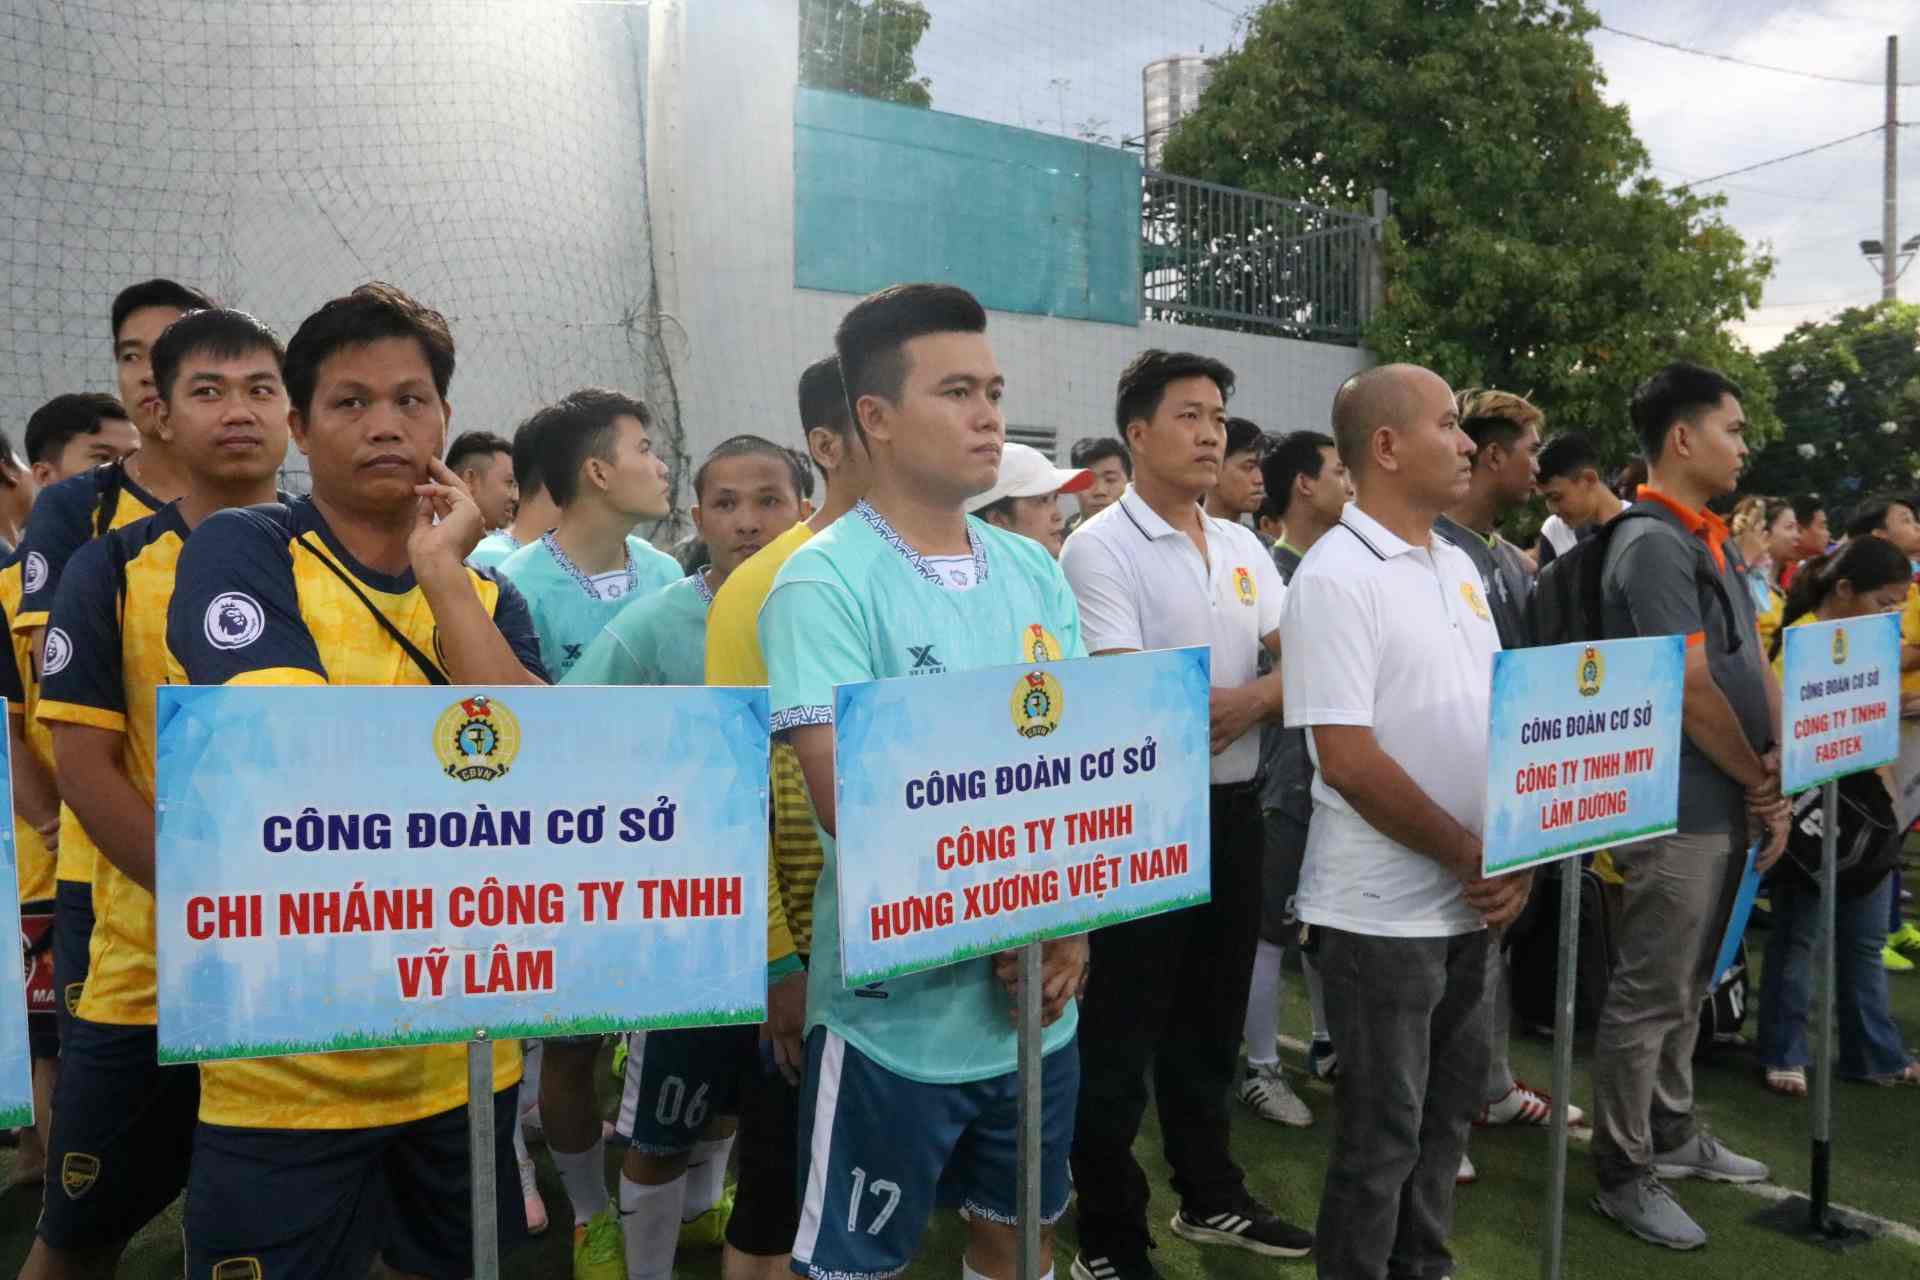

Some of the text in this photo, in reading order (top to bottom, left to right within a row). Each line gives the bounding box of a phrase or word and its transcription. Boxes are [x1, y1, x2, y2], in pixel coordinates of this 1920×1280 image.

[1521, 700, 1652, 745] CÔNG ĐOÀN CƠ SỞ
[1794, 701, 1887, 740] CÔNG TY TNHH
[906, 735, 1157, 810] CÔNG ĐOÀN CƠ SỞ
[1516, 748, 1654, 794] CÔNG TY TNHH MTV
[263, 796, 677, 852] CÔNG ĐOÀN CƠ SỞ
[1541, 790, 1627, 830] LÂM DƯƠNG
[936, 805, 1133, 871] CÔNG TY TNHH
[186, 876, 742, 941] CHI NHÁNH CÔNG TY TNHH
[871, 844, 1189, 941] HƯNG XƯƠNG VIỆT NAM
[398, 943, 554, 998] VỸ LÂM
[656, 1075, 710, 1129] 06
[847, 1166, 902, 1235] 17
